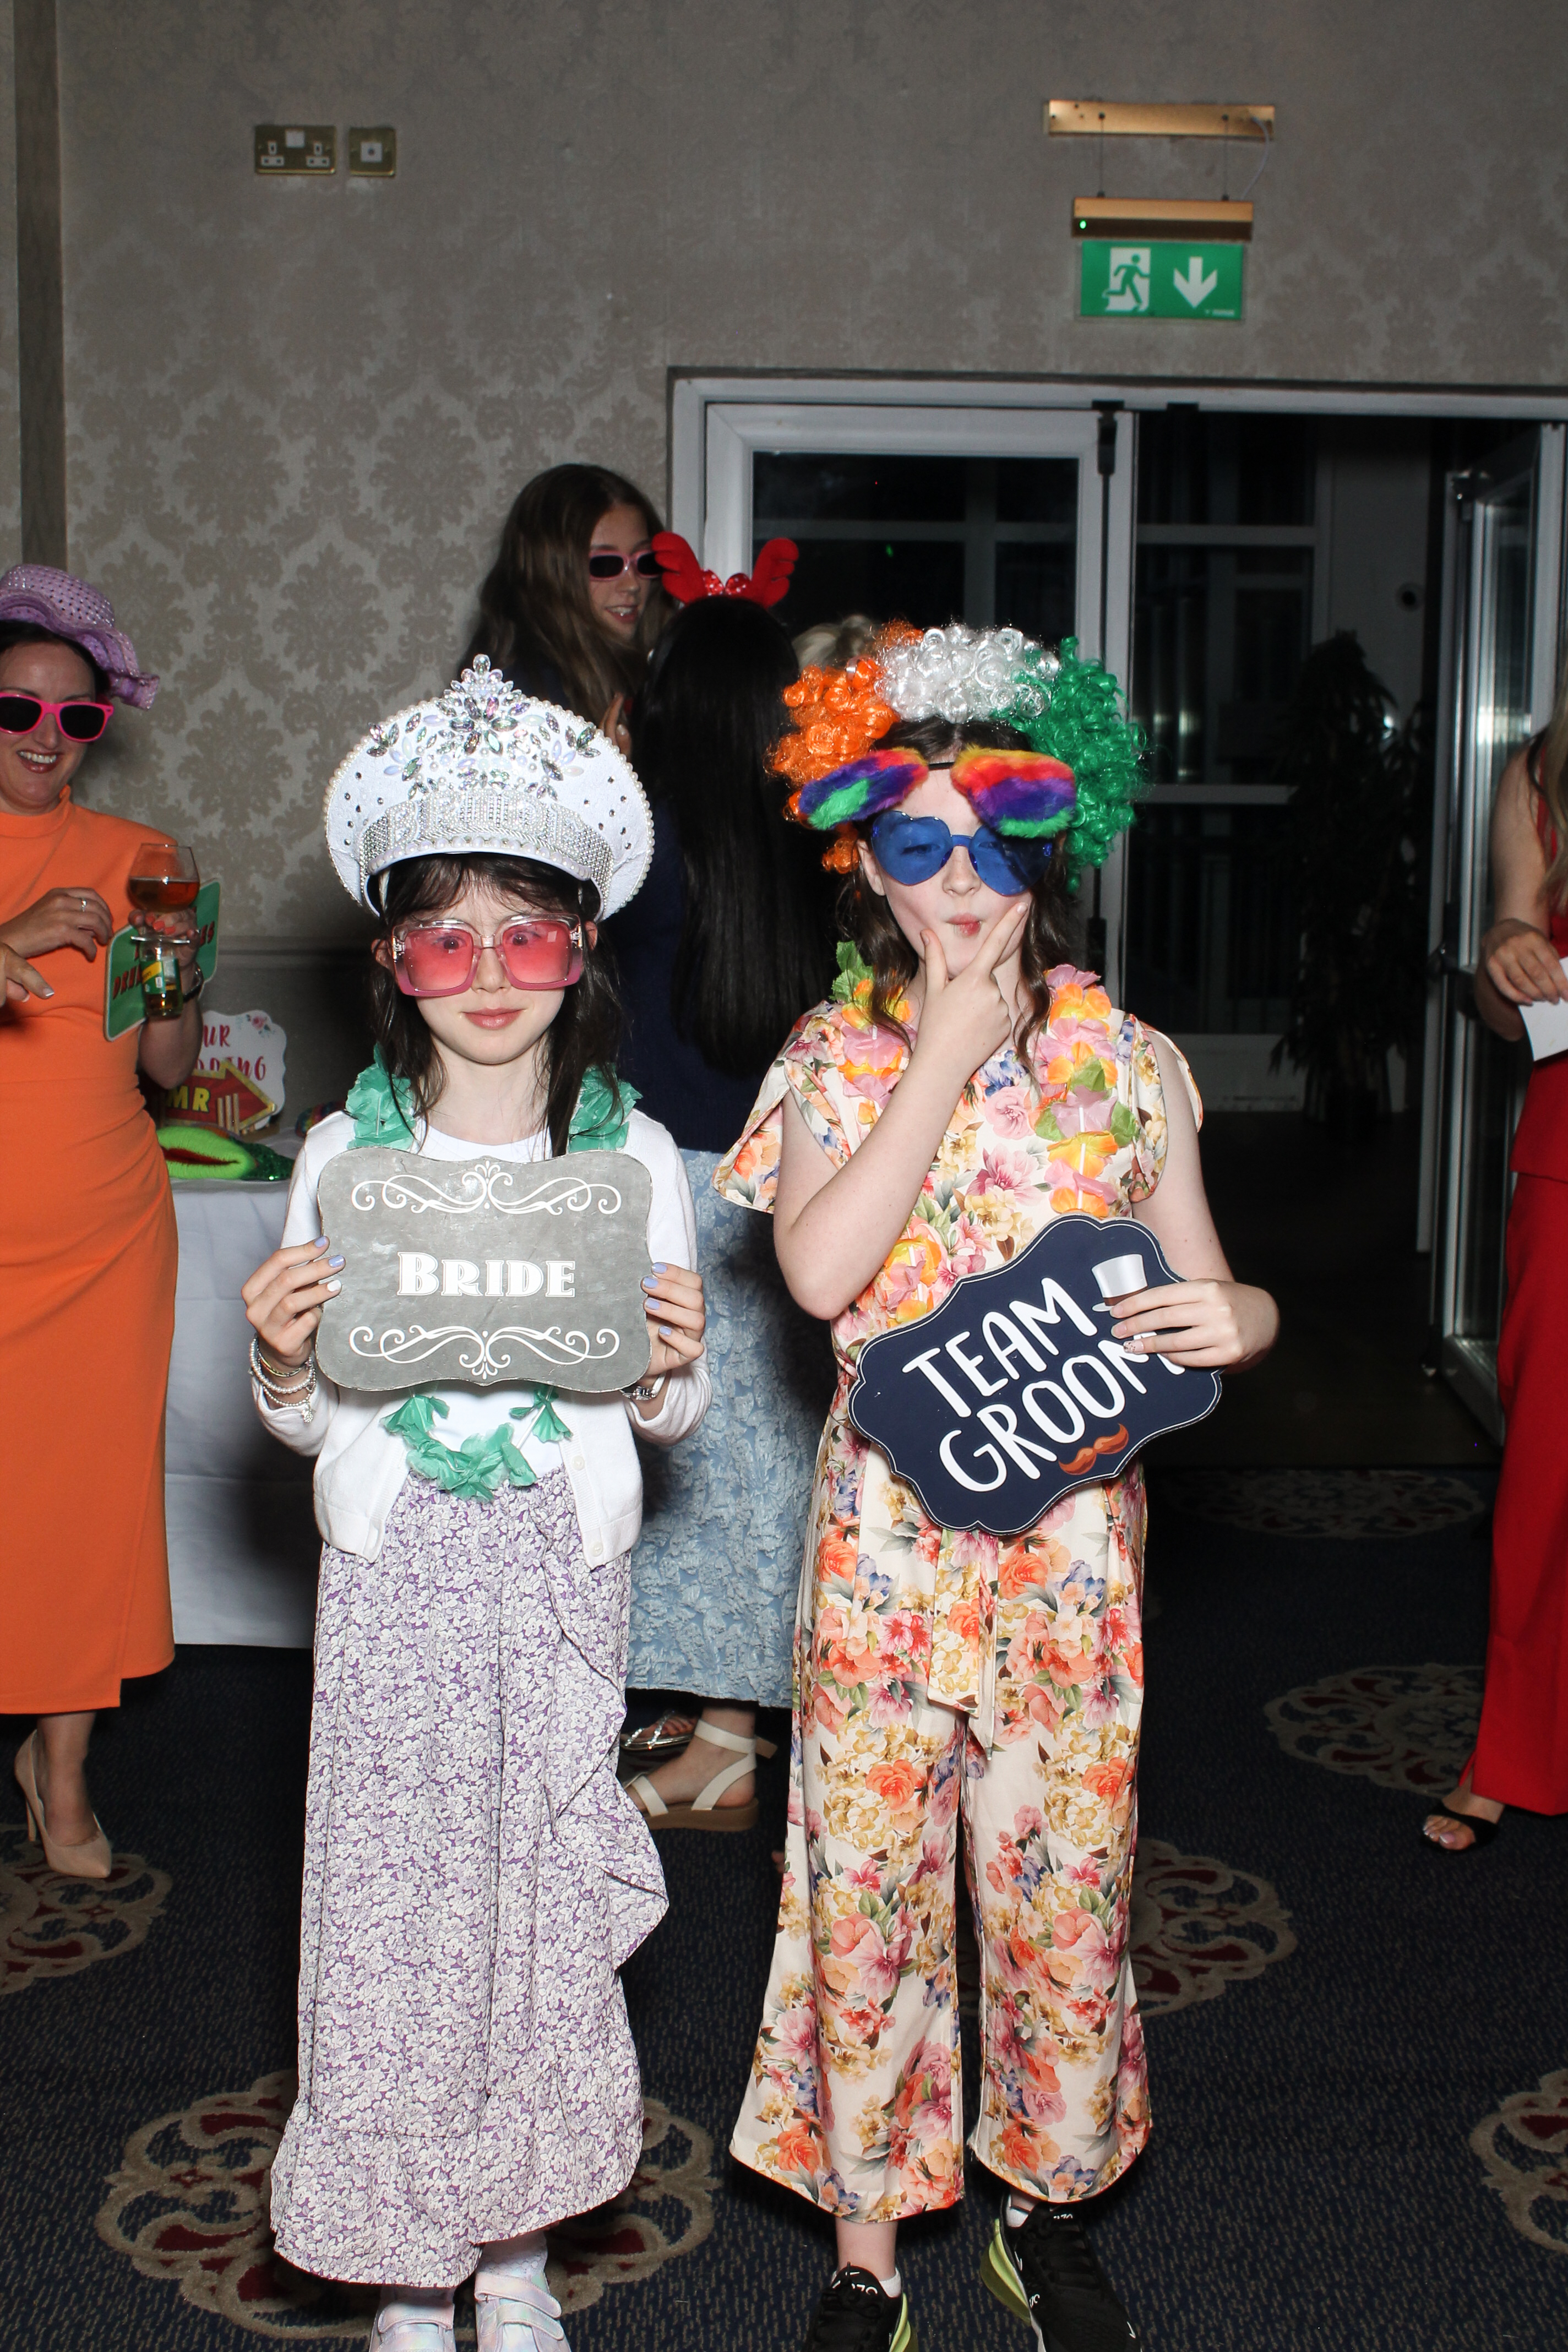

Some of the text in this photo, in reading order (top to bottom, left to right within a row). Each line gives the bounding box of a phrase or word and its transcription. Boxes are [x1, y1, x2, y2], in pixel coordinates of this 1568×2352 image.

[202, 1024, 230, 1048] UR
[396, 1251, 576, 1298] BRIDE
[902, 1277, 1097, 1418] TEAM
[939, 1331, 1185, 1492] GROOM
